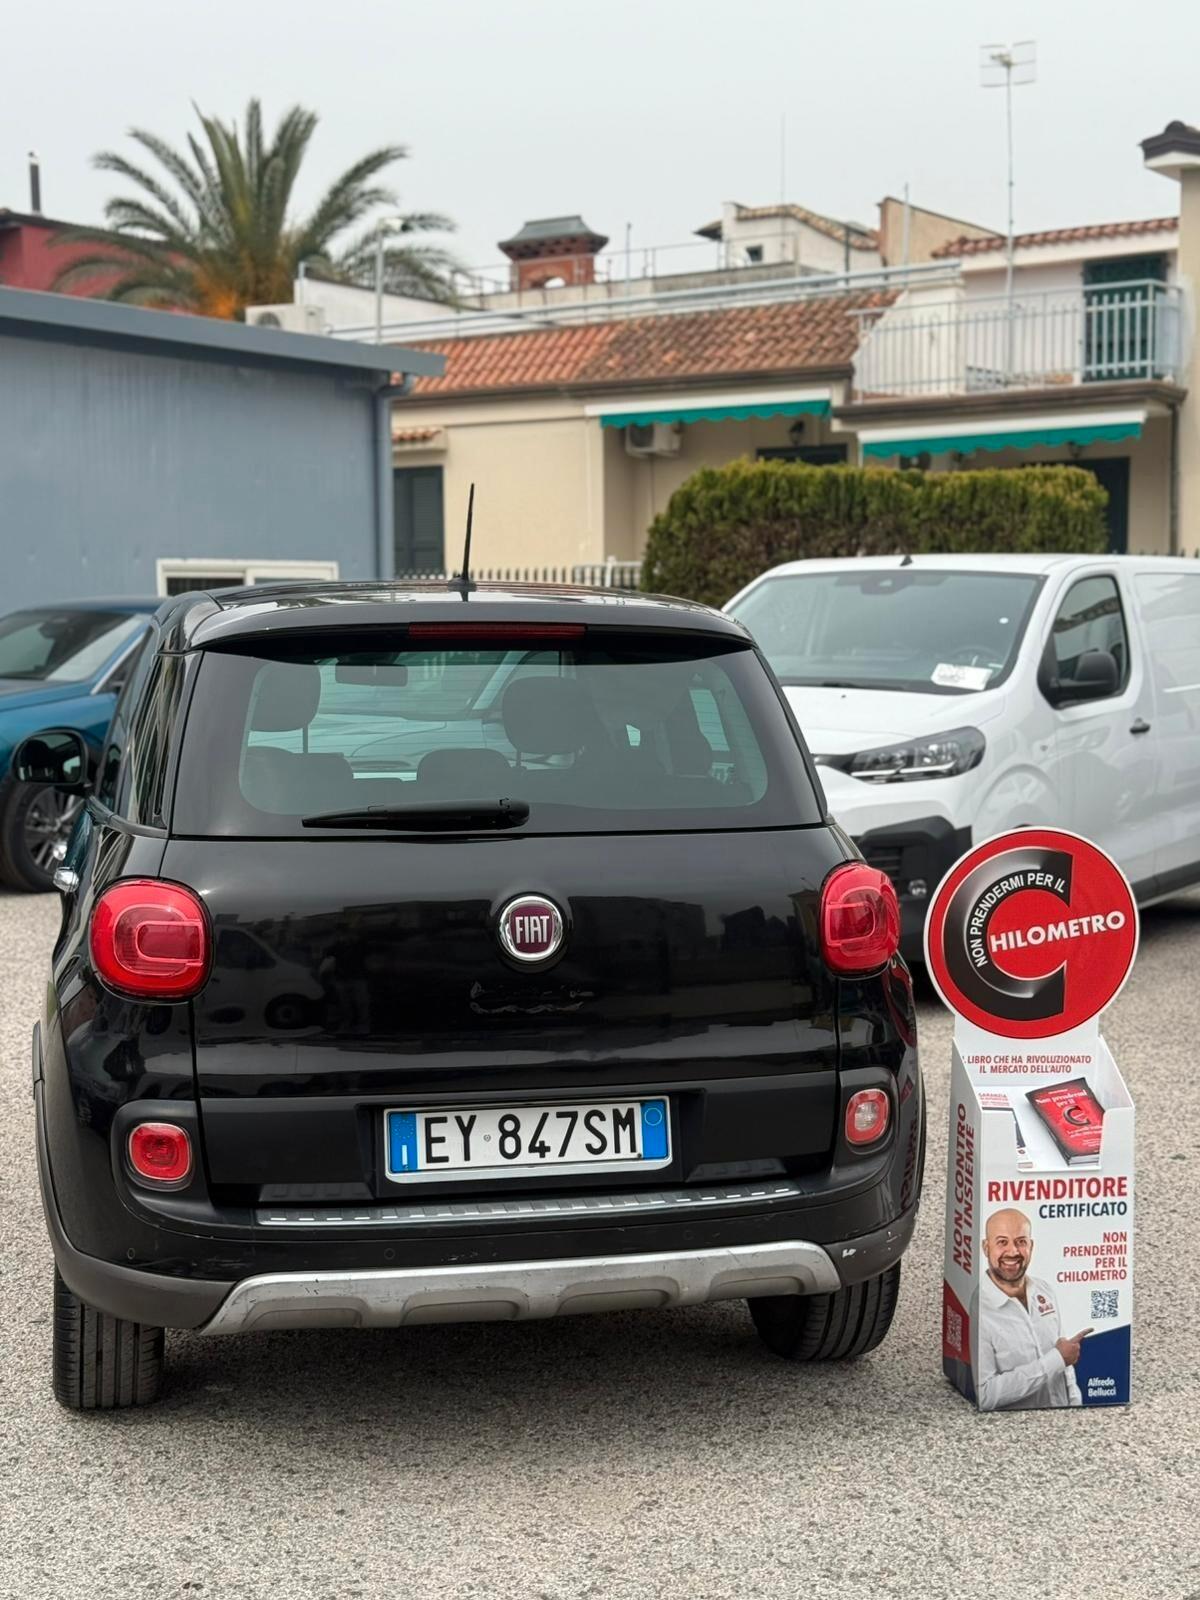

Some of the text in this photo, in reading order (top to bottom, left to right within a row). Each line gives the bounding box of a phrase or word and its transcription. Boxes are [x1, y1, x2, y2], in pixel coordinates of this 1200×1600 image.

[969, 872, 1066, 968] NON PRENDERMI PER IL
[514, 915, 550, 944] FIAT
[967, 1055, 992, 1064] LIBRO
[993, 1055, 1010, 1064] CHE
[1011, 1055, 1023, 1064] HA
[1026, 1055, 1092, 1064] RIVOLUZIONATO
[979, 1064, 1072, 1074] IL MERCATO DELL'AUTO
[424, 1107, 637, 1164] EY 847SM
[953, 1103, 966, 1266] NON CONTRO
[988, 1176, 1128, 1202] RIVENDITORE
[963, 1123, 974, 1276] MA INSIEME
[1039, 1201, 1128, 1219] CERTIFICATO
[1103, 1231, 1127, 1243] NON
[1063, 1245, 1127, 1257] PRENDERMI
[1095, 1257, 1128, 1268] PER IL
[1056, 1269, 1127, 1283] CHILOMETRO
[1087, 1377, 1115, 1387] Alfredo
[1088, 1387, 1117, 1397] Bellucci
